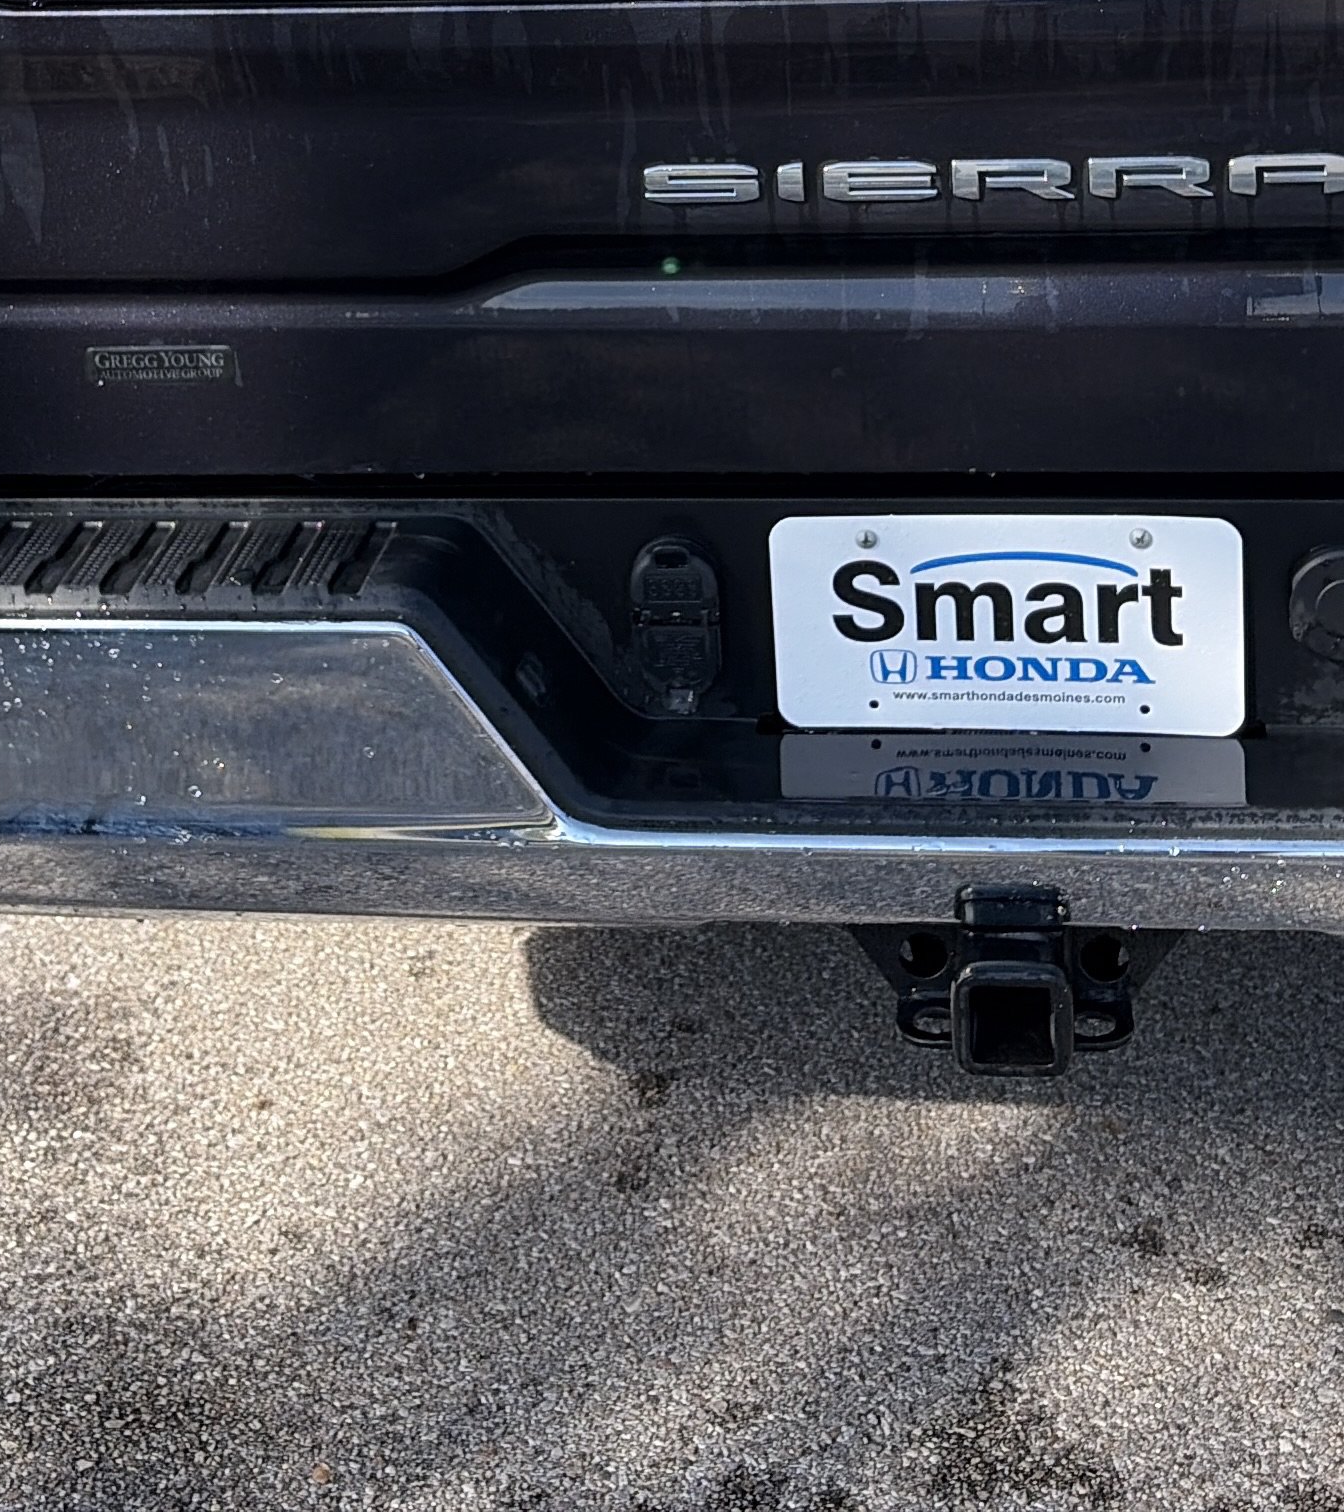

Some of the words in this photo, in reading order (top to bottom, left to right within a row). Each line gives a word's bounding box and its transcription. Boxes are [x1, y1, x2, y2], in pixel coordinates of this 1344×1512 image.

[94, 352, 157, 368] GREGG
[159, 351, 224, 367] YOUNG
[100, 369, 181, 380] AUTOMOTIVE
[181, 368, 223, 378] GROUP
[832, 560, 1183, 646] Smart
[925, 656, 1156, 684] HONDA
[893, 690, 1126, 704] www.smarthondadesmoines.com
